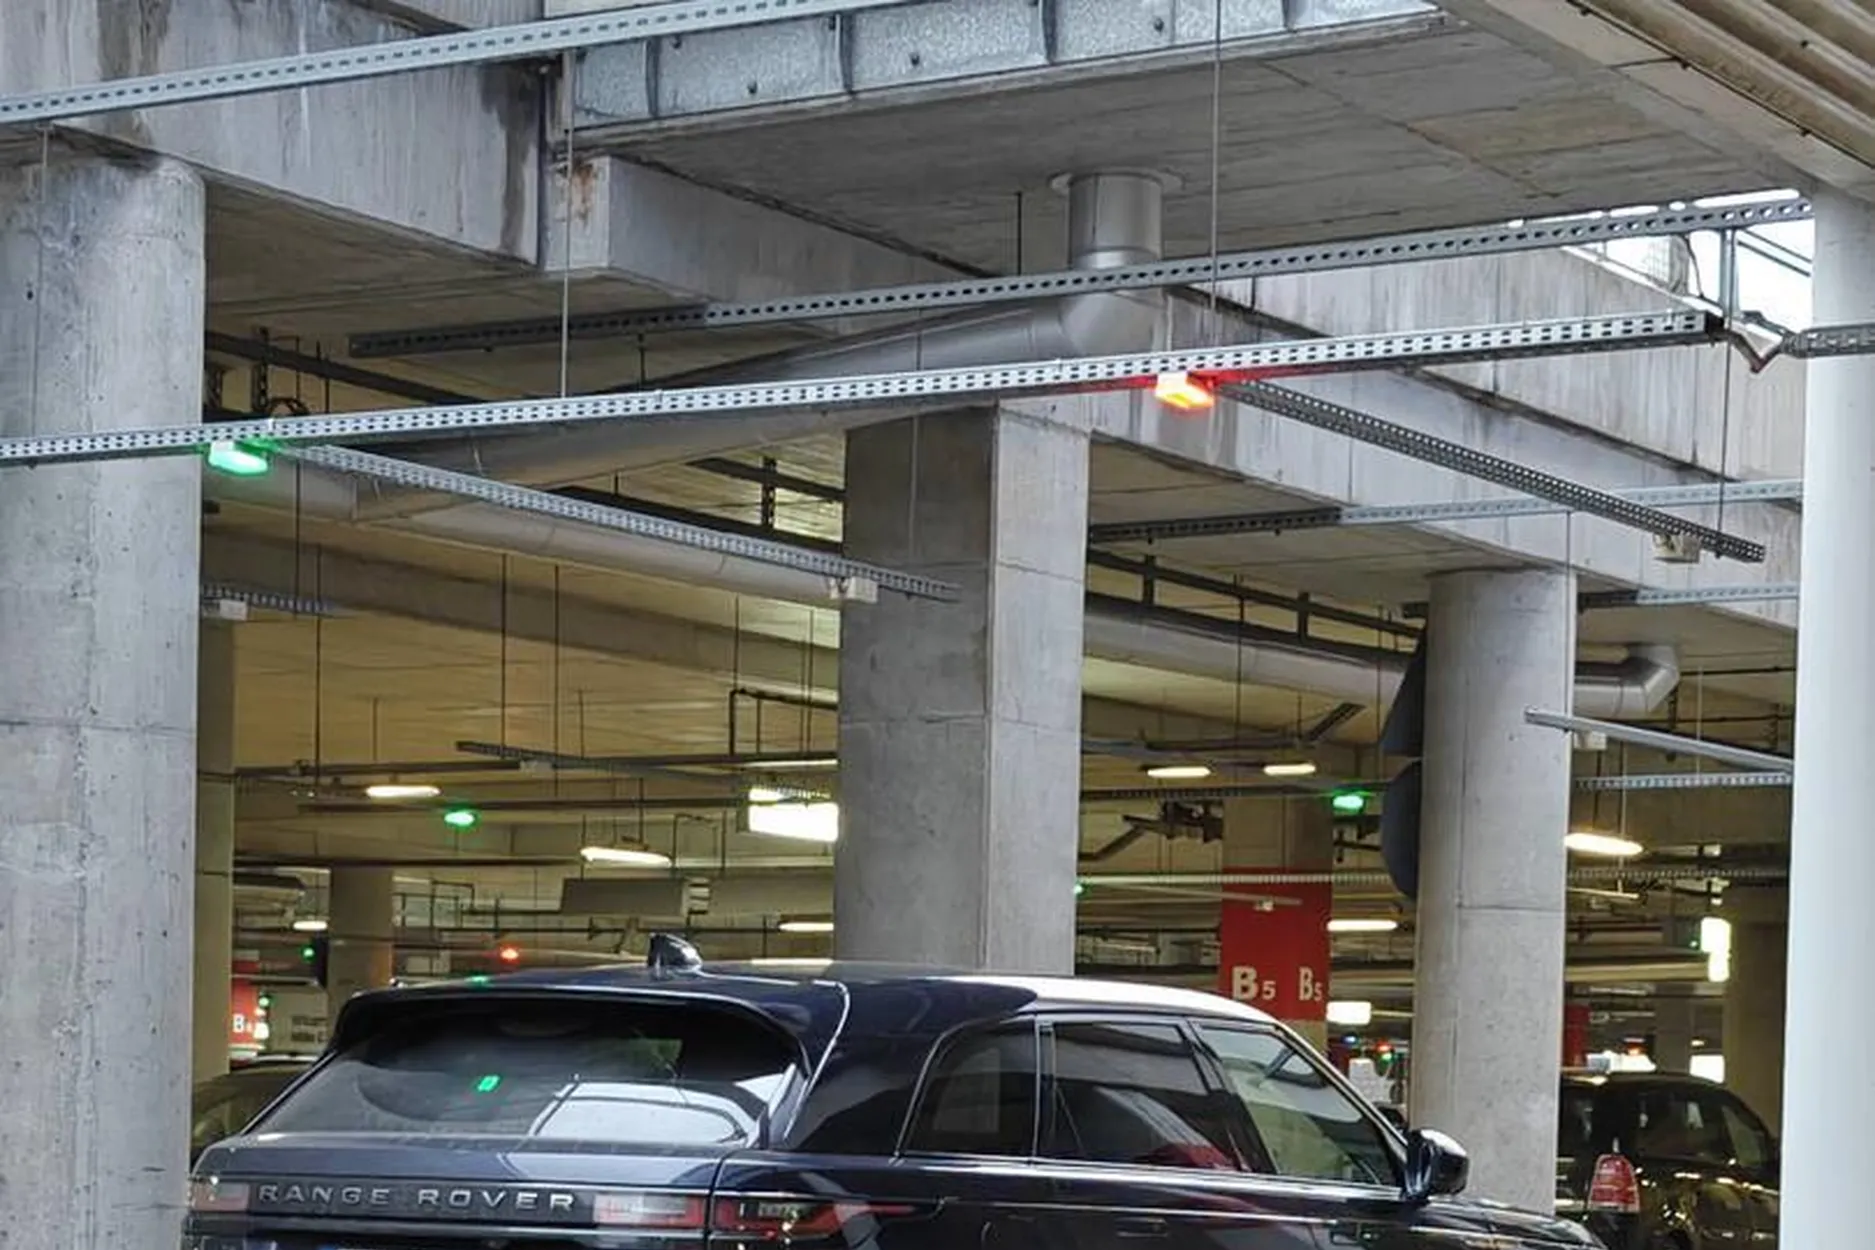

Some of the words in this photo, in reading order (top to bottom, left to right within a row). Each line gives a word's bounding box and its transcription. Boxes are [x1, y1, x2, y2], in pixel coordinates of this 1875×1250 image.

[1232, 965, 1276, 1000] B5
[260, 1184, 389, 1206] RANGE
[420, 1189, 575, 1211] ROVER
